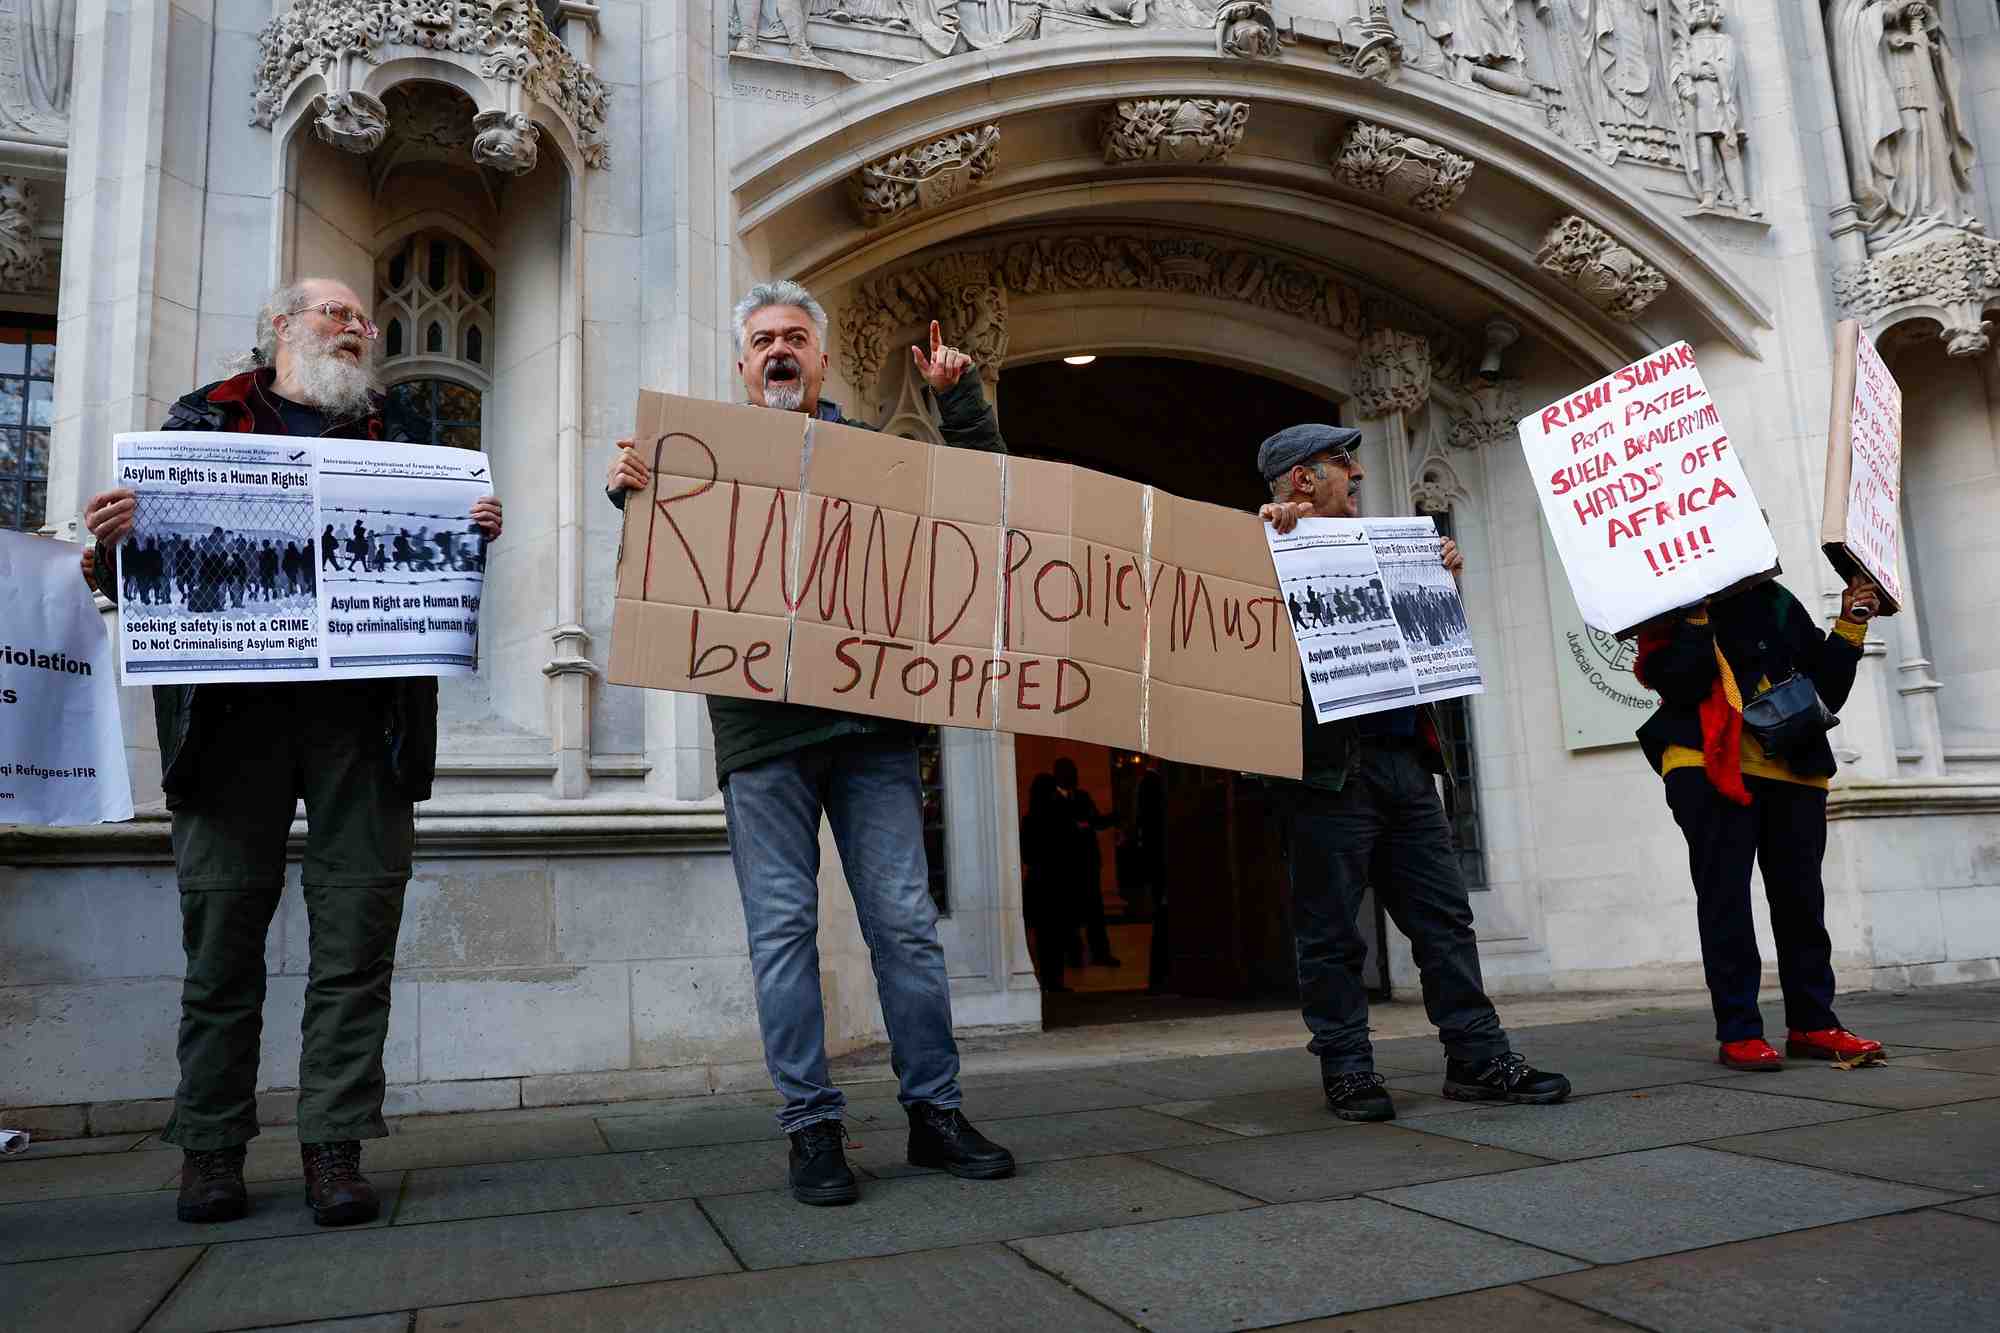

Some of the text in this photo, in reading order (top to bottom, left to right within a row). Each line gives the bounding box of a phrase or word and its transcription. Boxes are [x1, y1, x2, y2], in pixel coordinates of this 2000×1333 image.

[1540, 381, 1612, 434] RISHI
[123, 466, 308, 489] Asylum Rights is a Human Rights!
[1551, 452, 1617, 495] SUELA
[1573, 436, 1727, 526] HANDS OFF
[1608, 477, 1737, 548] AFRICA
[1644, 526, 1716, 577] !!!!!
[330, 597, 370, 613] Asylum
[372, 596, 401, 612] Right
[402, 599, 421, 609] are
[423, 595, 459, 609] Human
[126, 619, 310, 635] seeking safety is not a CRIME
[328, 620, 353, 635] Stop
[356, 618, 426, 634] criminalising
[428, 617, 462, 631] human
[132, 636, 318, 652] Do Not Criminalising Asylum Right!
[687, 608, 1091, 718] be STOPPED
[1308, 649, 1334, 664] Asylum
[1310, 671, 1329, 684] Stop
[1566, 631, 1595, 675] Judicial
[1589, 672, 1653, 709] Committee
[16, 764, 97, 779] Refugees-IFIR
